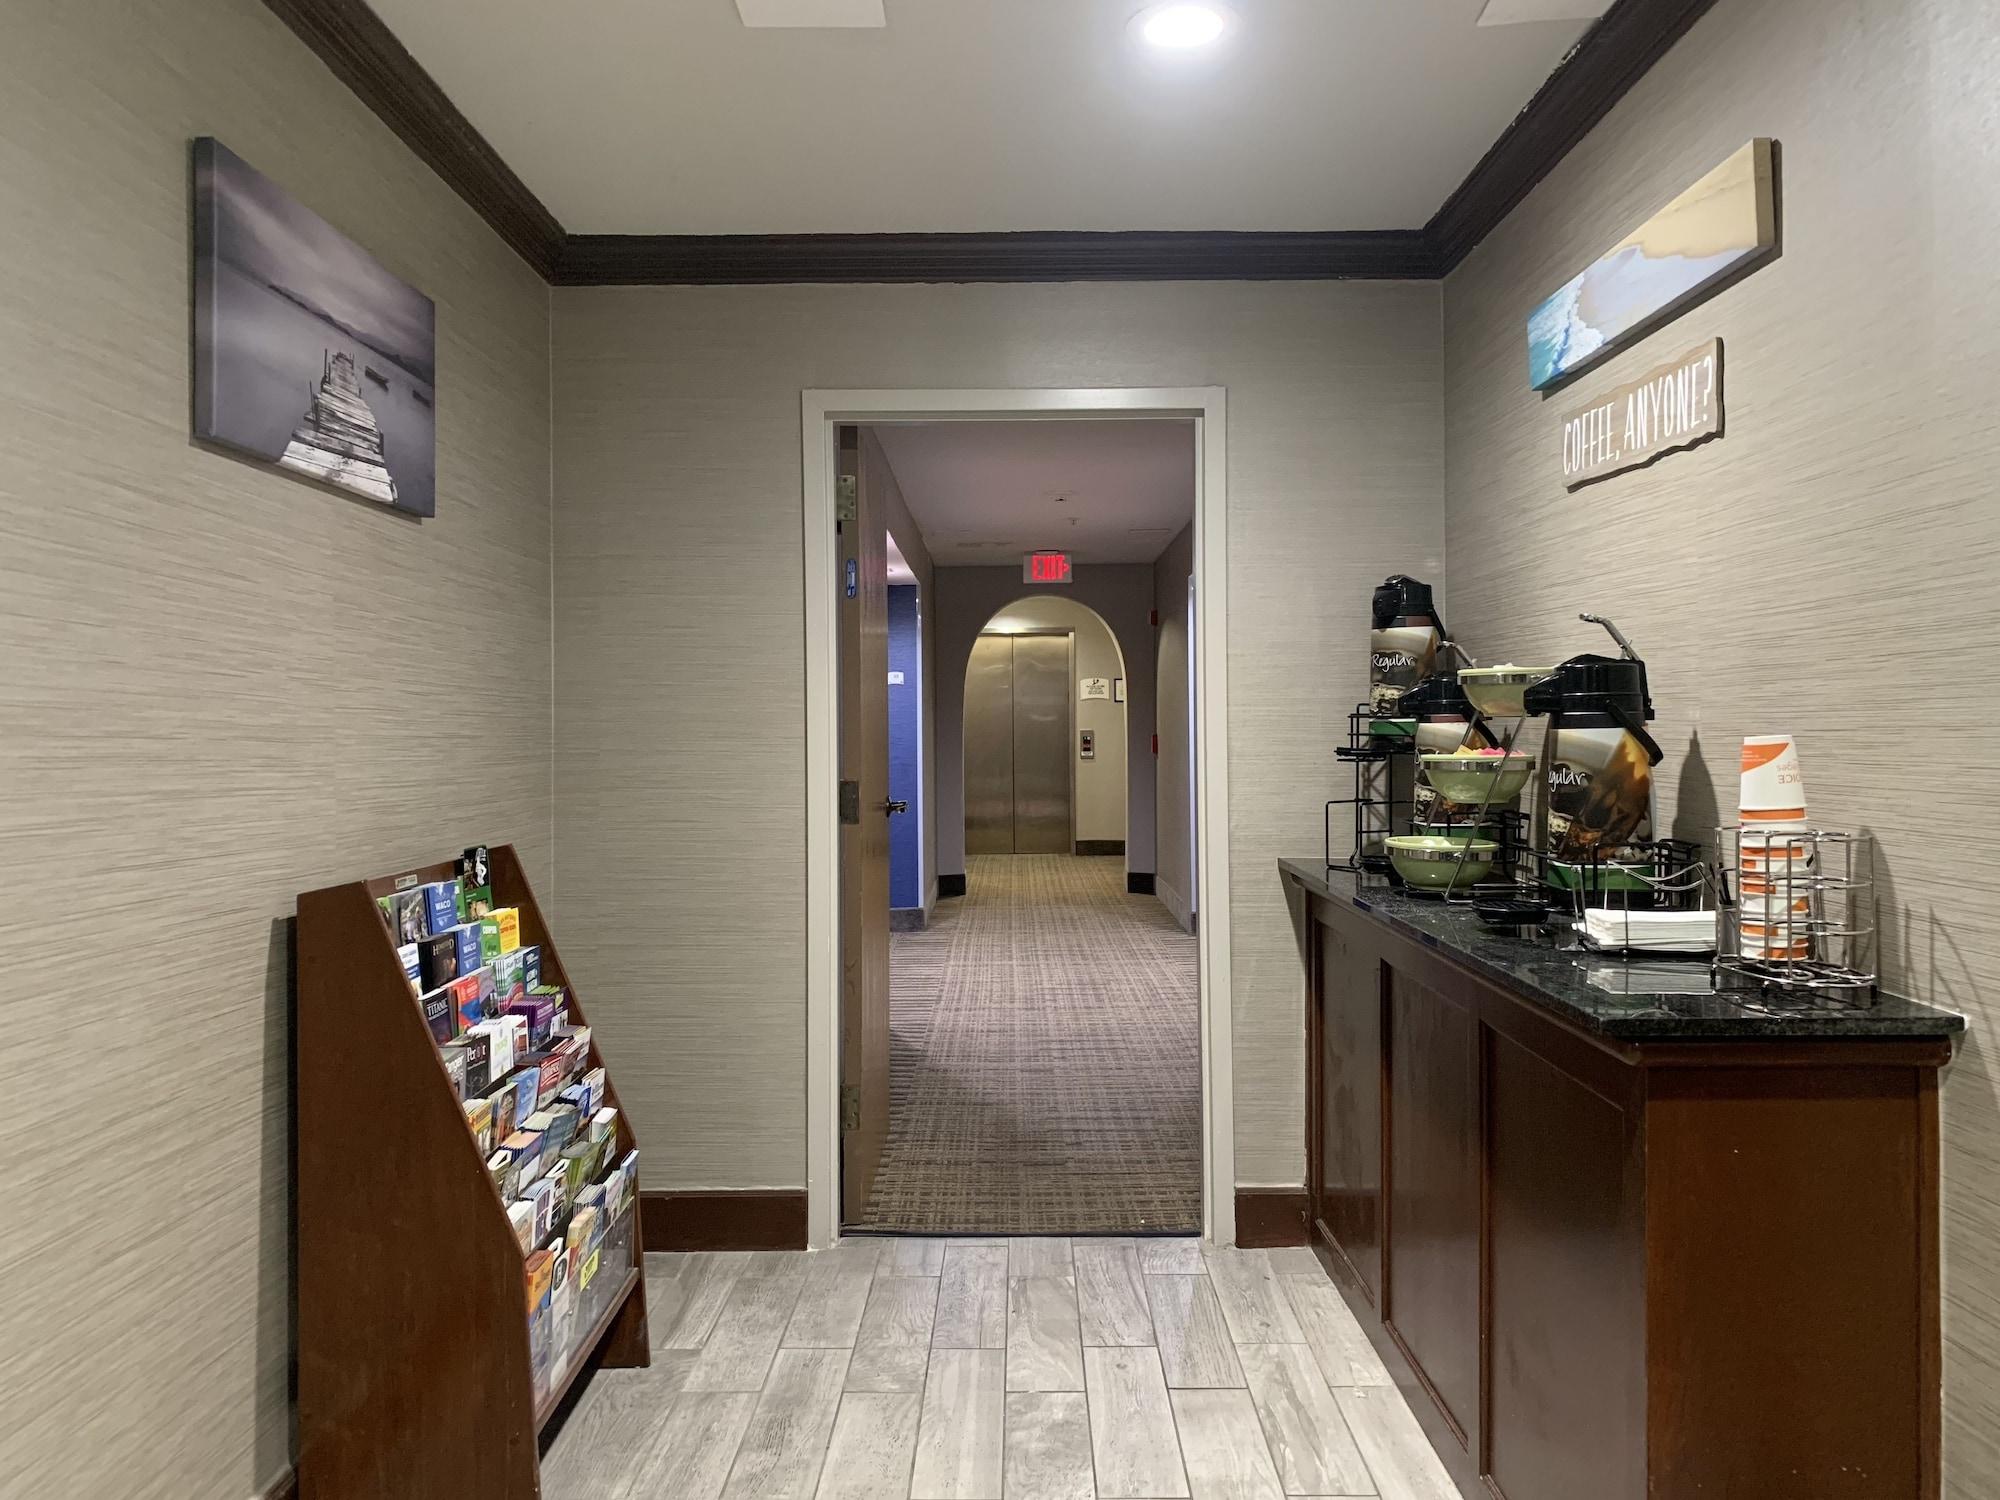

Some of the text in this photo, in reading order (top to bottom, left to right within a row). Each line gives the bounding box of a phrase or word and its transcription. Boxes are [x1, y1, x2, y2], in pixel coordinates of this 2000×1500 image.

[1563, 355, 1713, 475] COFFEE, ANYONE?
[1032, 555, 1065, 580] EXIT
[1372, 654, 1414, 673] Regular
[1548, 768, 1586, 792] egular
[435, 900, 451, 911] WACO
[463, 942, 477, 954] WACO
[427, 999, 448, 1016] TITANIC
